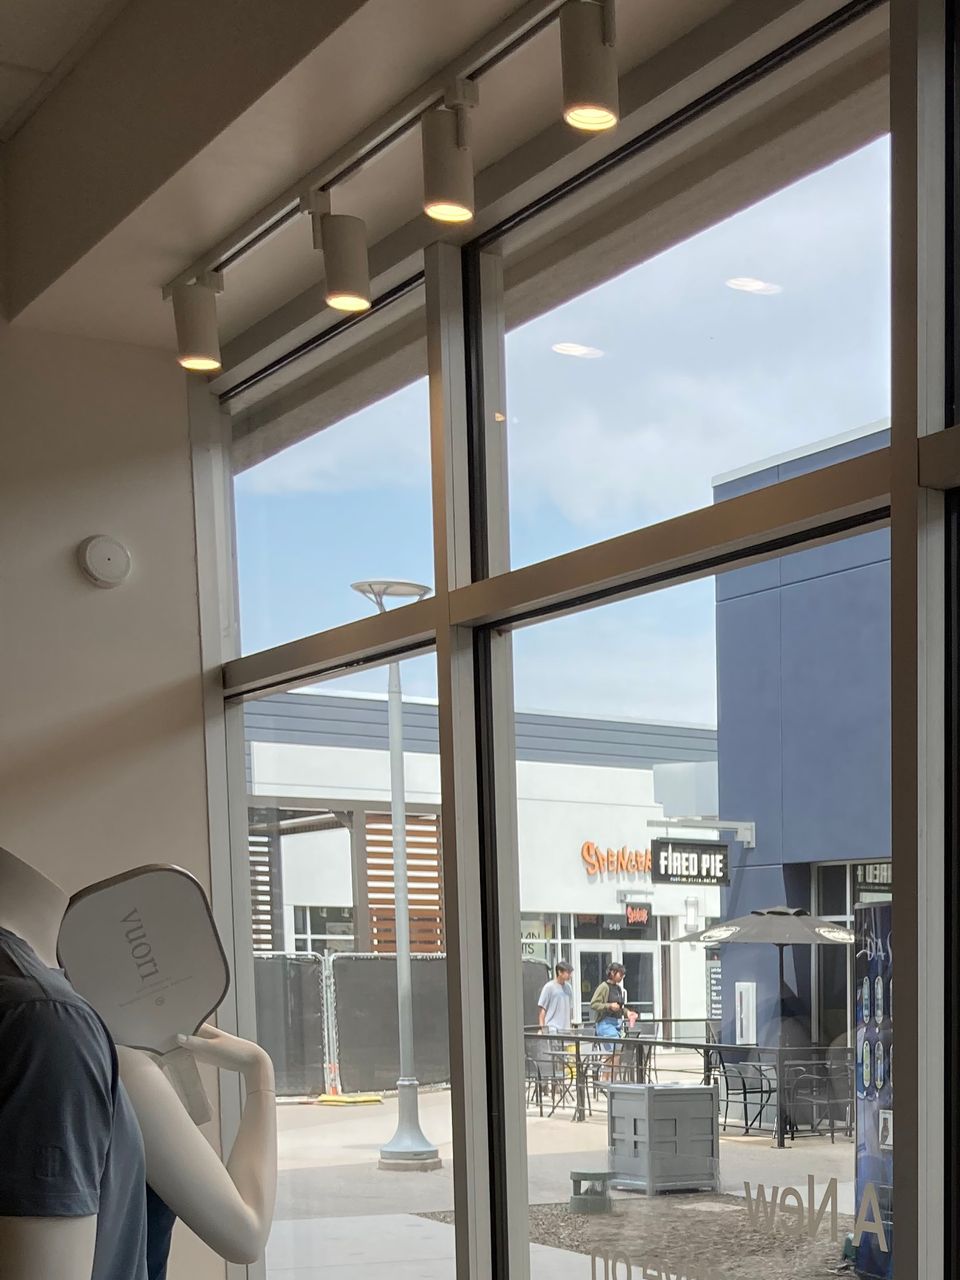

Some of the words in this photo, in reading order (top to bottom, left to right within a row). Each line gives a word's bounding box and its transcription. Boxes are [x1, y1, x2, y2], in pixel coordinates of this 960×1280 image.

[659, 843, 698, 876] FIRED
[701, 853, 723, 878] PIE
[119, 906, 160, 981] vuori
